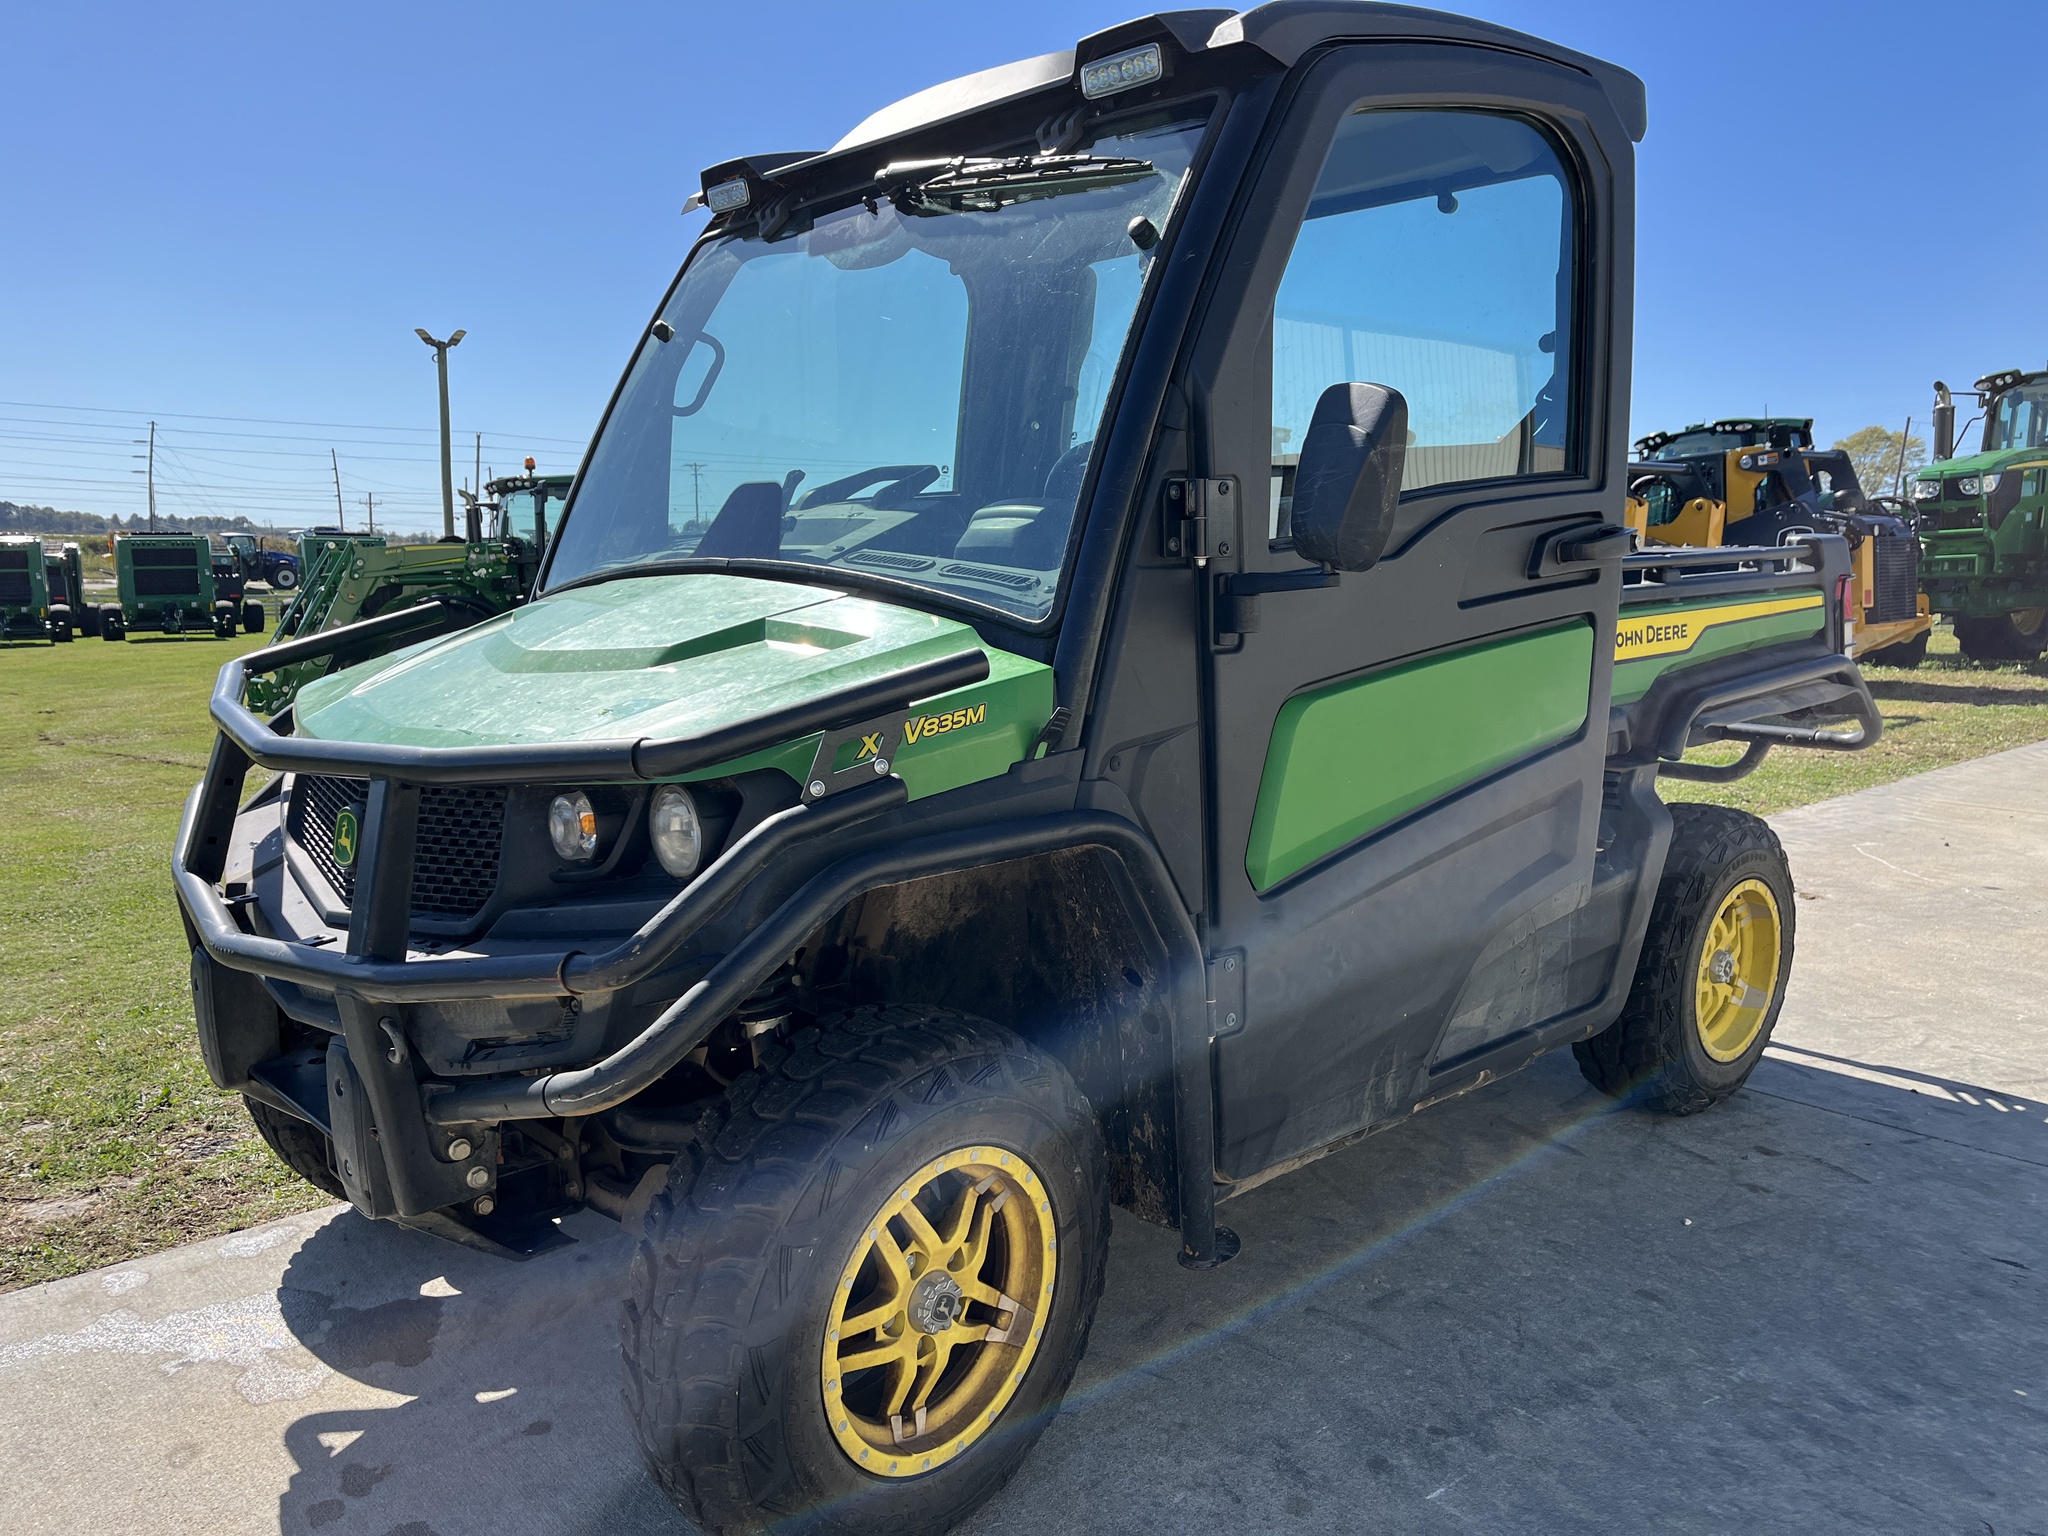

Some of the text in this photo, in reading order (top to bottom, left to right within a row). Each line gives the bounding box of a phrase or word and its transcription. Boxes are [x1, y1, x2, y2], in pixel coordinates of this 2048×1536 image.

[1615, 624, 1688, 648] OHN DEERE
[854, 702, 987, 761] XV835M
[1721, 852, 1767, 883] KUMHO
